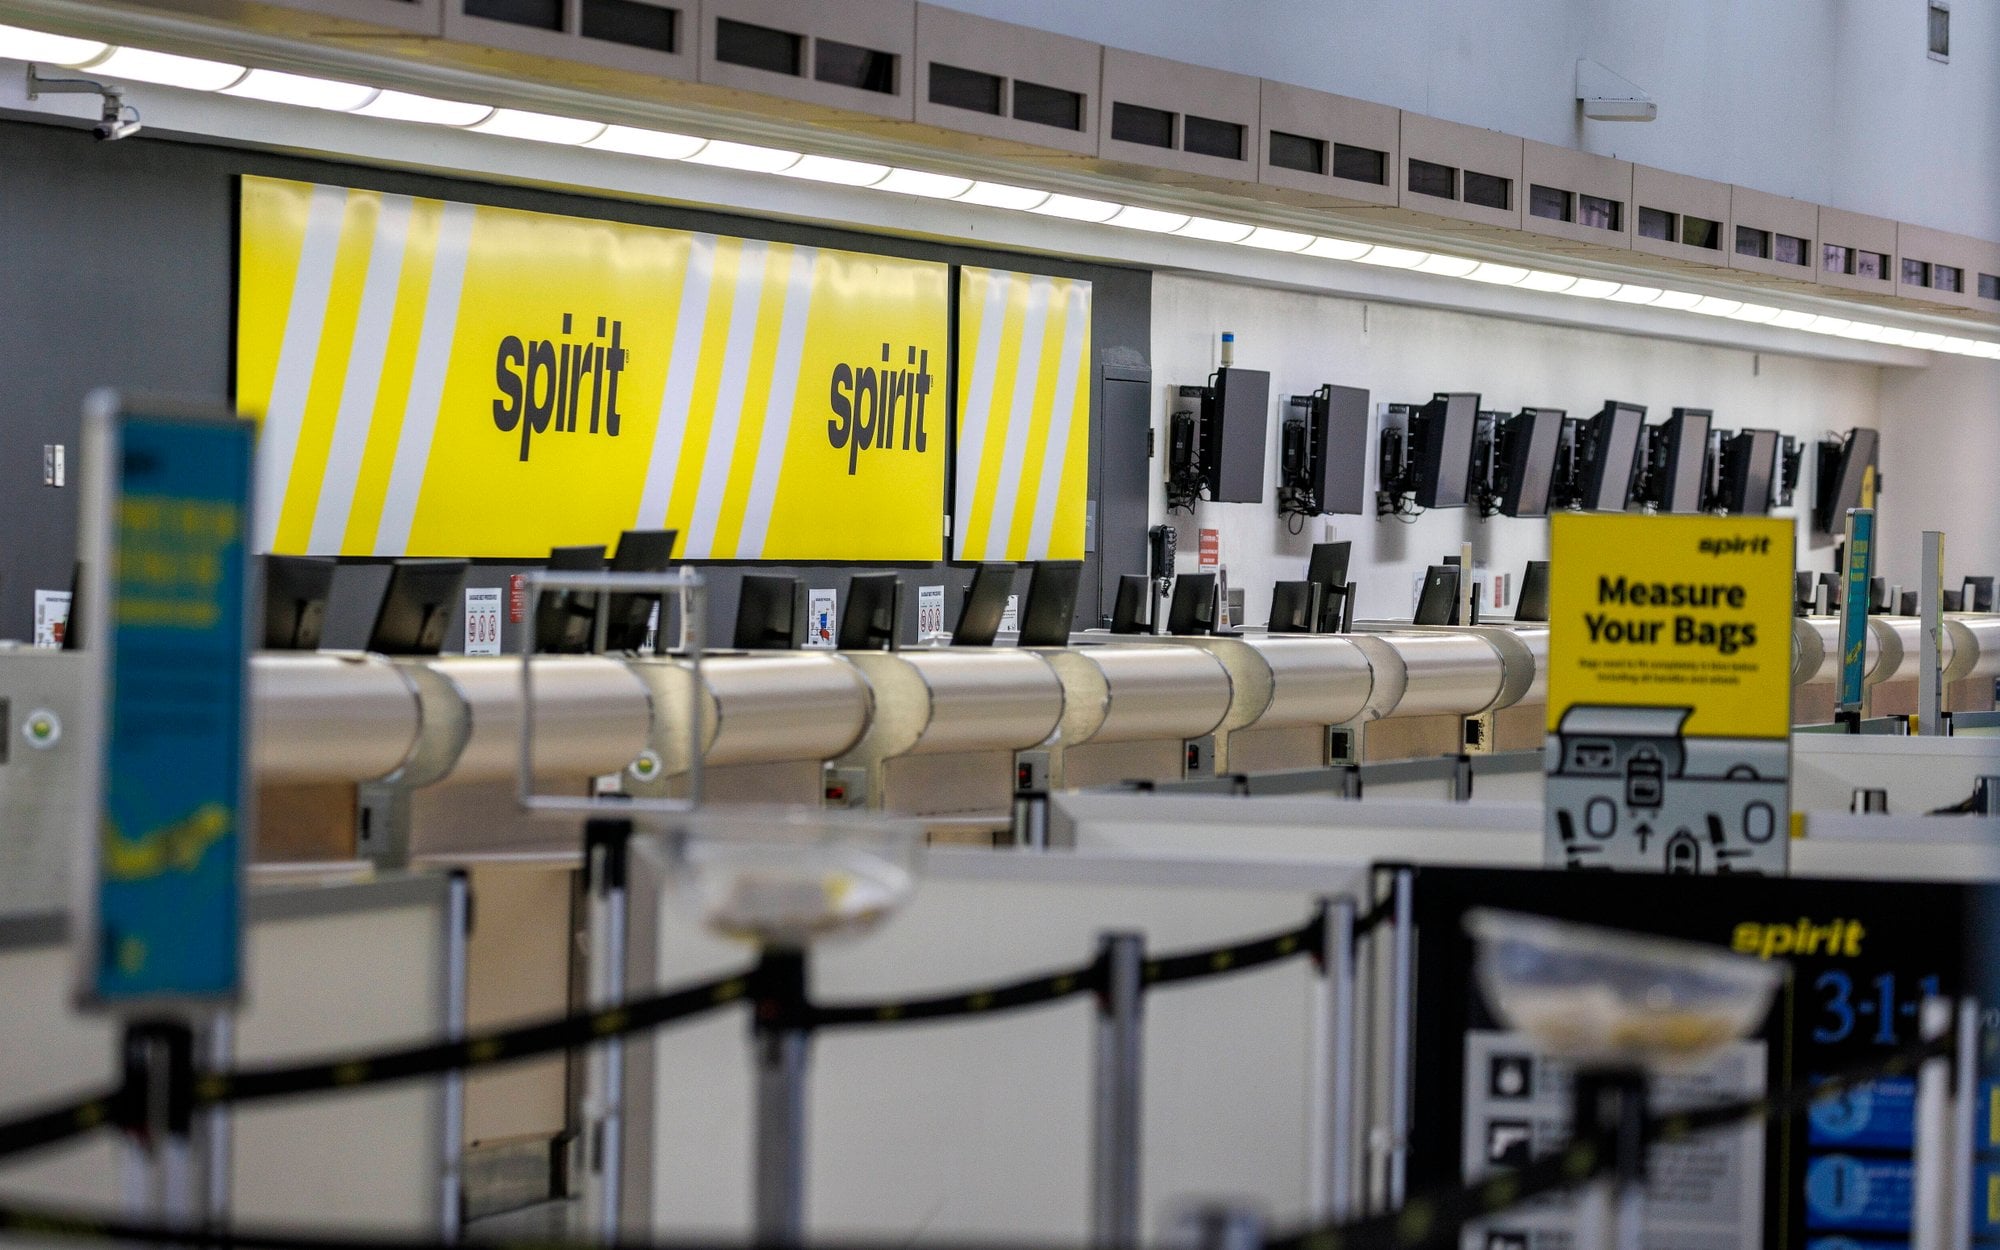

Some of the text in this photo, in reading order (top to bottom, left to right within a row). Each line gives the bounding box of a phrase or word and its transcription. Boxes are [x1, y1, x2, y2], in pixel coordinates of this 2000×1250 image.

[493, 313, 625, 462] spirit
[827, 343, 930, 475] spirit
[1698, 536, 1770, 557] spirit
[1598, 575, 1746, 609] Measure
[1584, 613, 1758, 655] Your Bags
[1731, 916, 1865, 961] spirit
